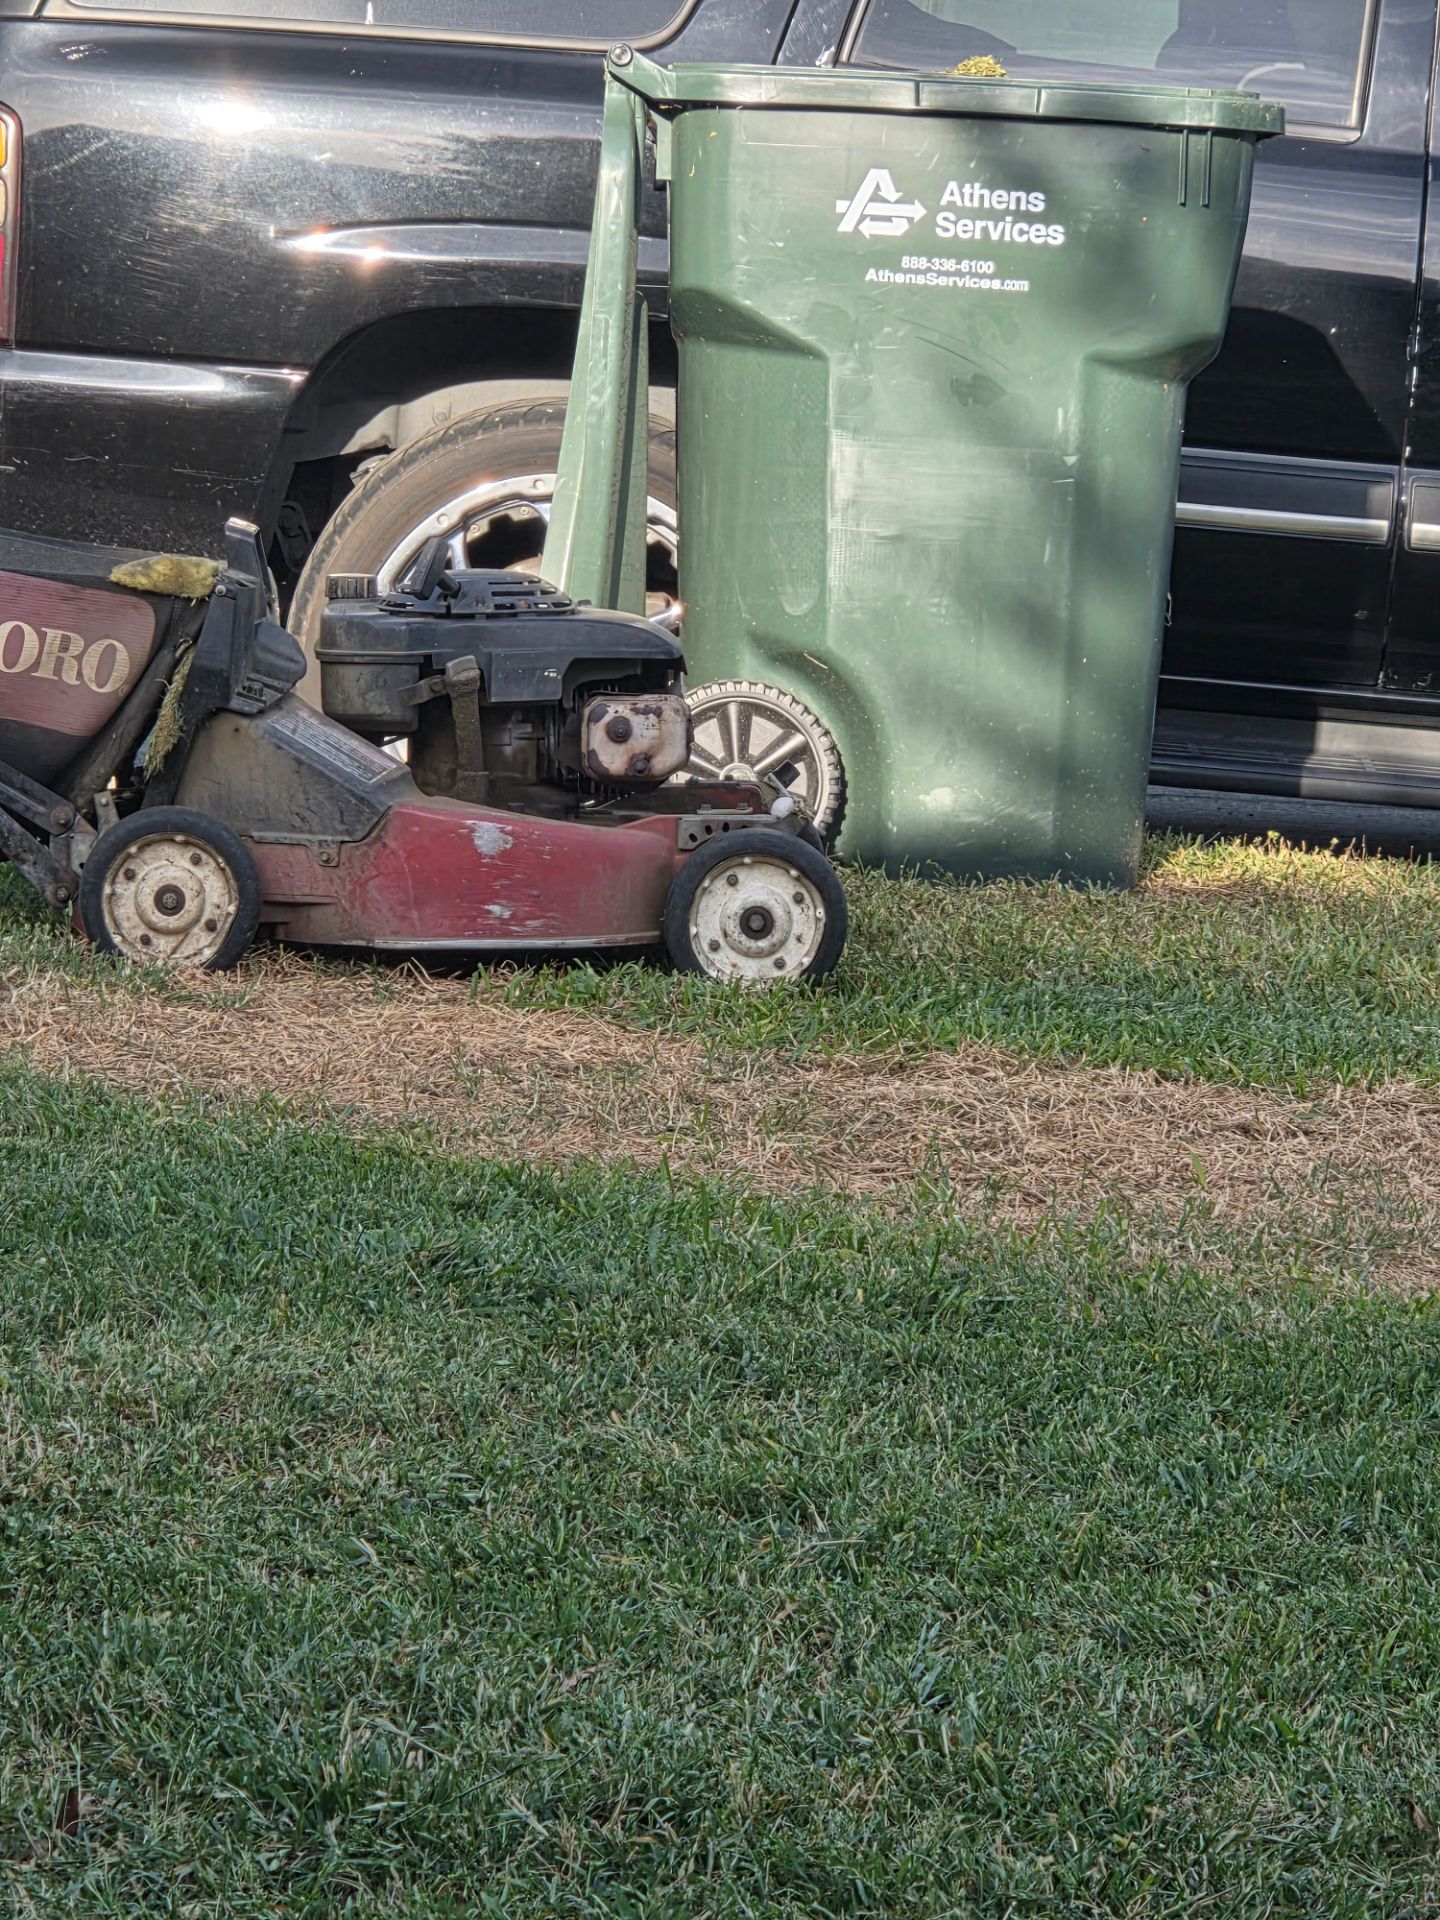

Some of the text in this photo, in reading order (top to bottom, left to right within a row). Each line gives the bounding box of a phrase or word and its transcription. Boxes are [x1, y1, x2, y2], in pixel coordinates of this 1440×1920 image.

[940, 180, 1047, 212] Athens
[935, 211, 1066, 246] Services
[901, 256, 995, 274] 888-336-6100
[865, 268, 1029, 291] AthensServices.com
